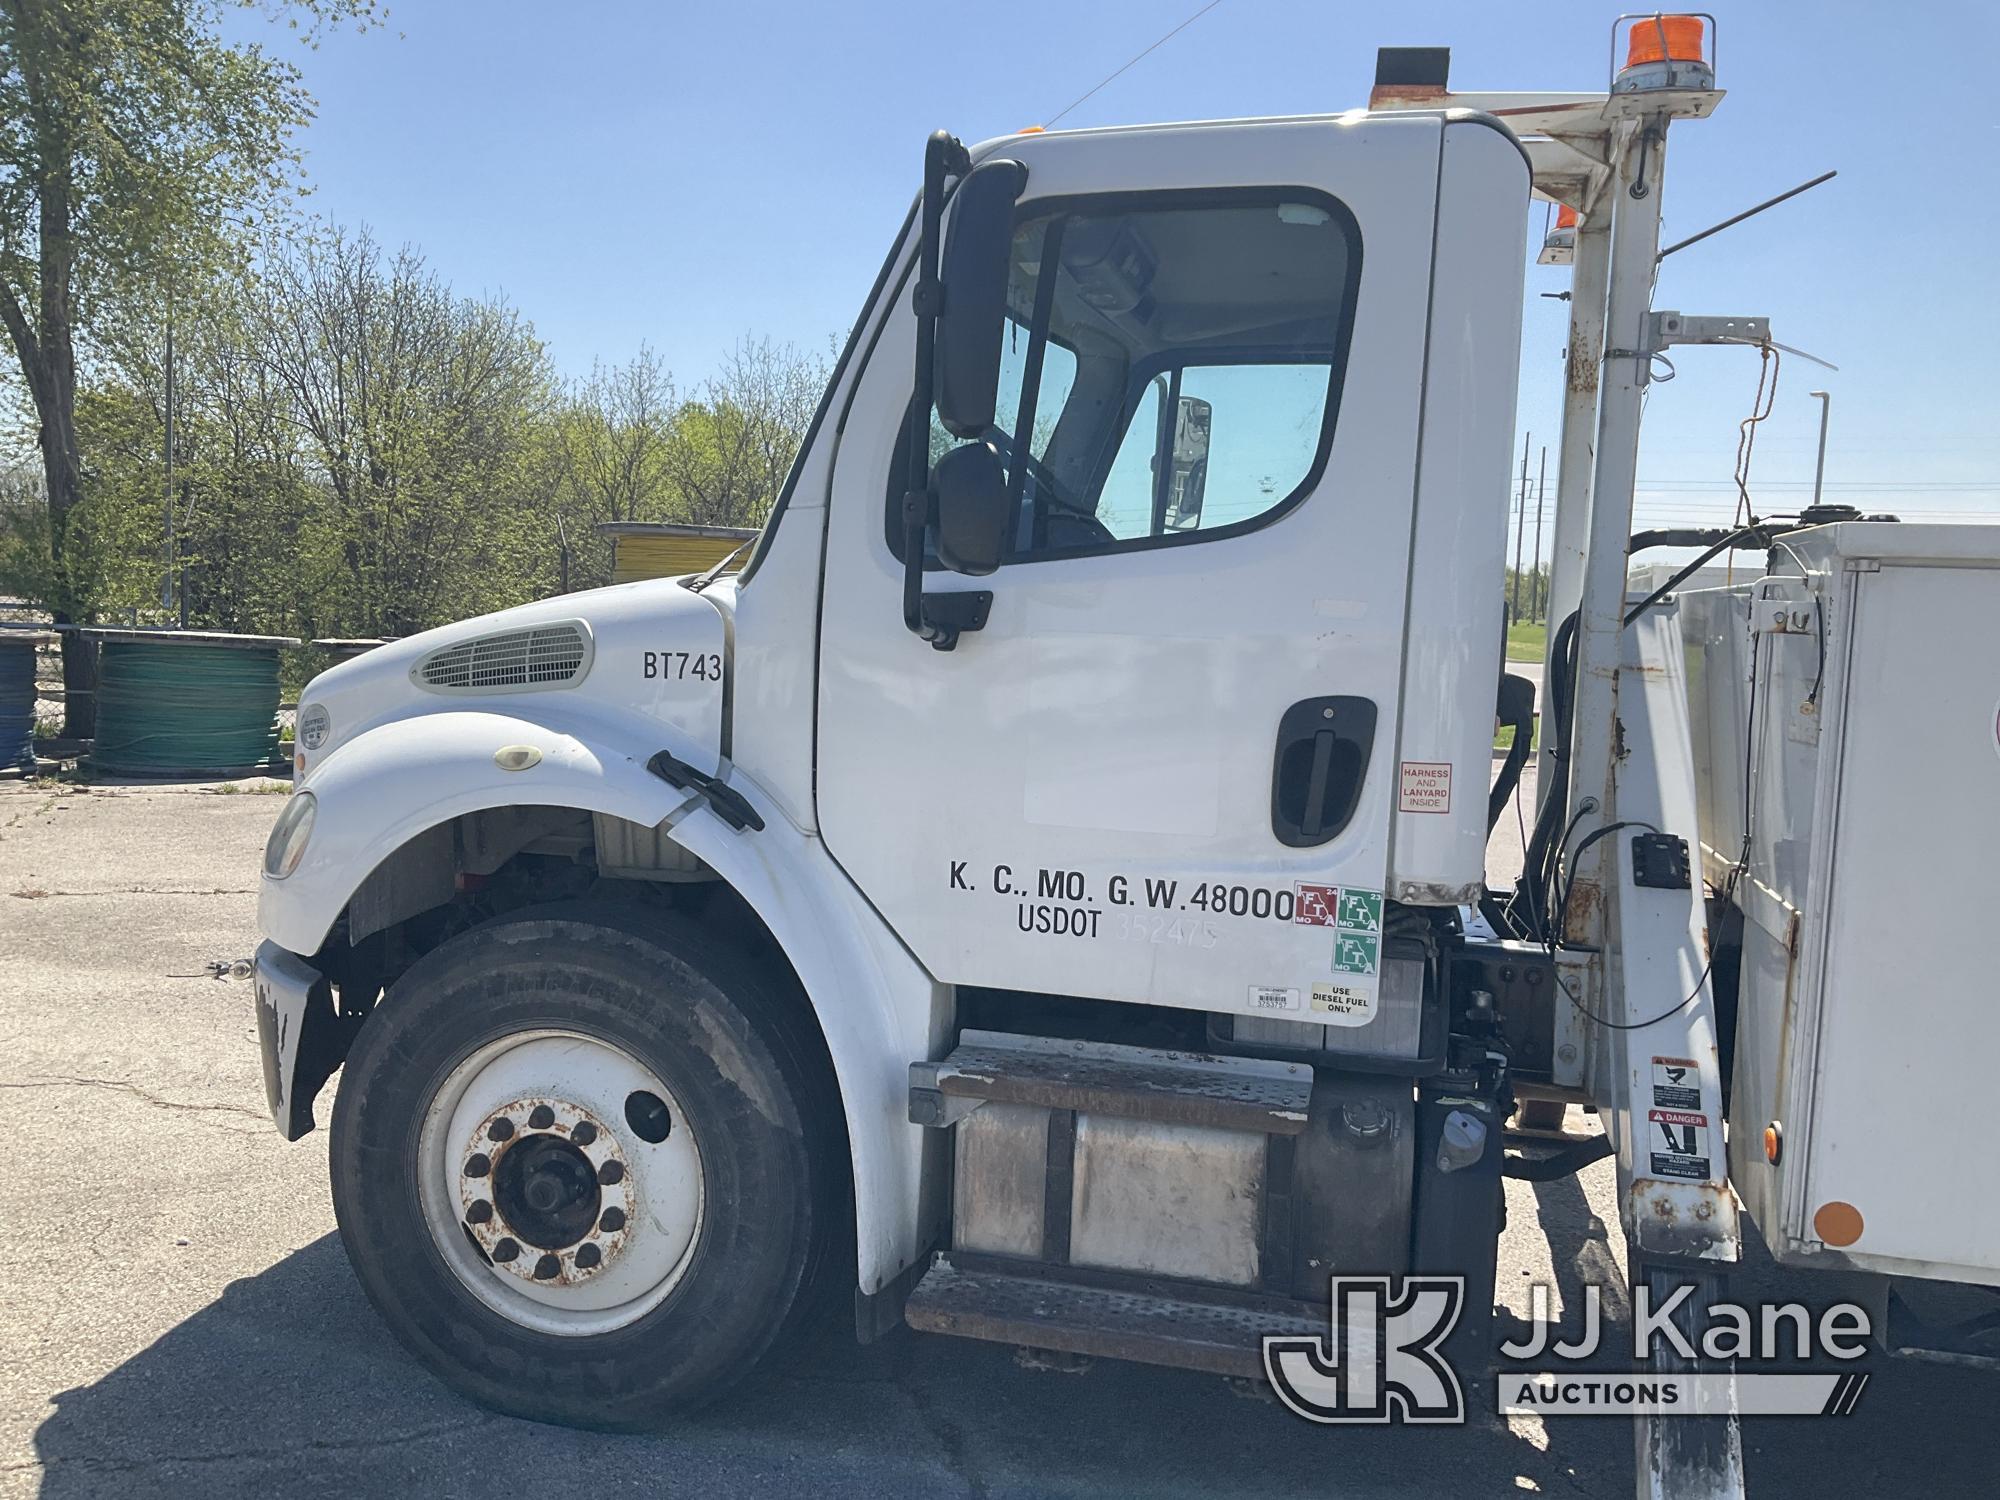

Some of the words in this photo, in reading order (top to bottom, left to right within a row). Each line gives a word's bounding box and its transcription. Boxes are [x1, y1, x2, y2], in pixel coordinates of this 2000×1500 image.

[644, 651, 721, 681] BT743
[1404, 769, 1448, 778] HARNESS
[1416, 779, 1436, 787] AND
[1403, 789, 1447, 797] LANYARD
[1410, 798, 1440, 807] INSIDE
[1326, 888, 1337, 896] 24
[1370, 893, 1380, 901] 23
[1018, 904, 1102, 938] USDOT
[1296, 916, 1311, 924] MO
[1339, 920, 1354, 928] MO
[1335, 963, 1350, 971] MO
[1333, 987, 1350, 995] USE
[1312, 993, 1344, 1004] DIESEL
[1346, 997, 1368, 1007] FUEL
[1328, 1004, 1351, 1013] ONLY
[1666, 1114, 1702, 1124] DANGER
